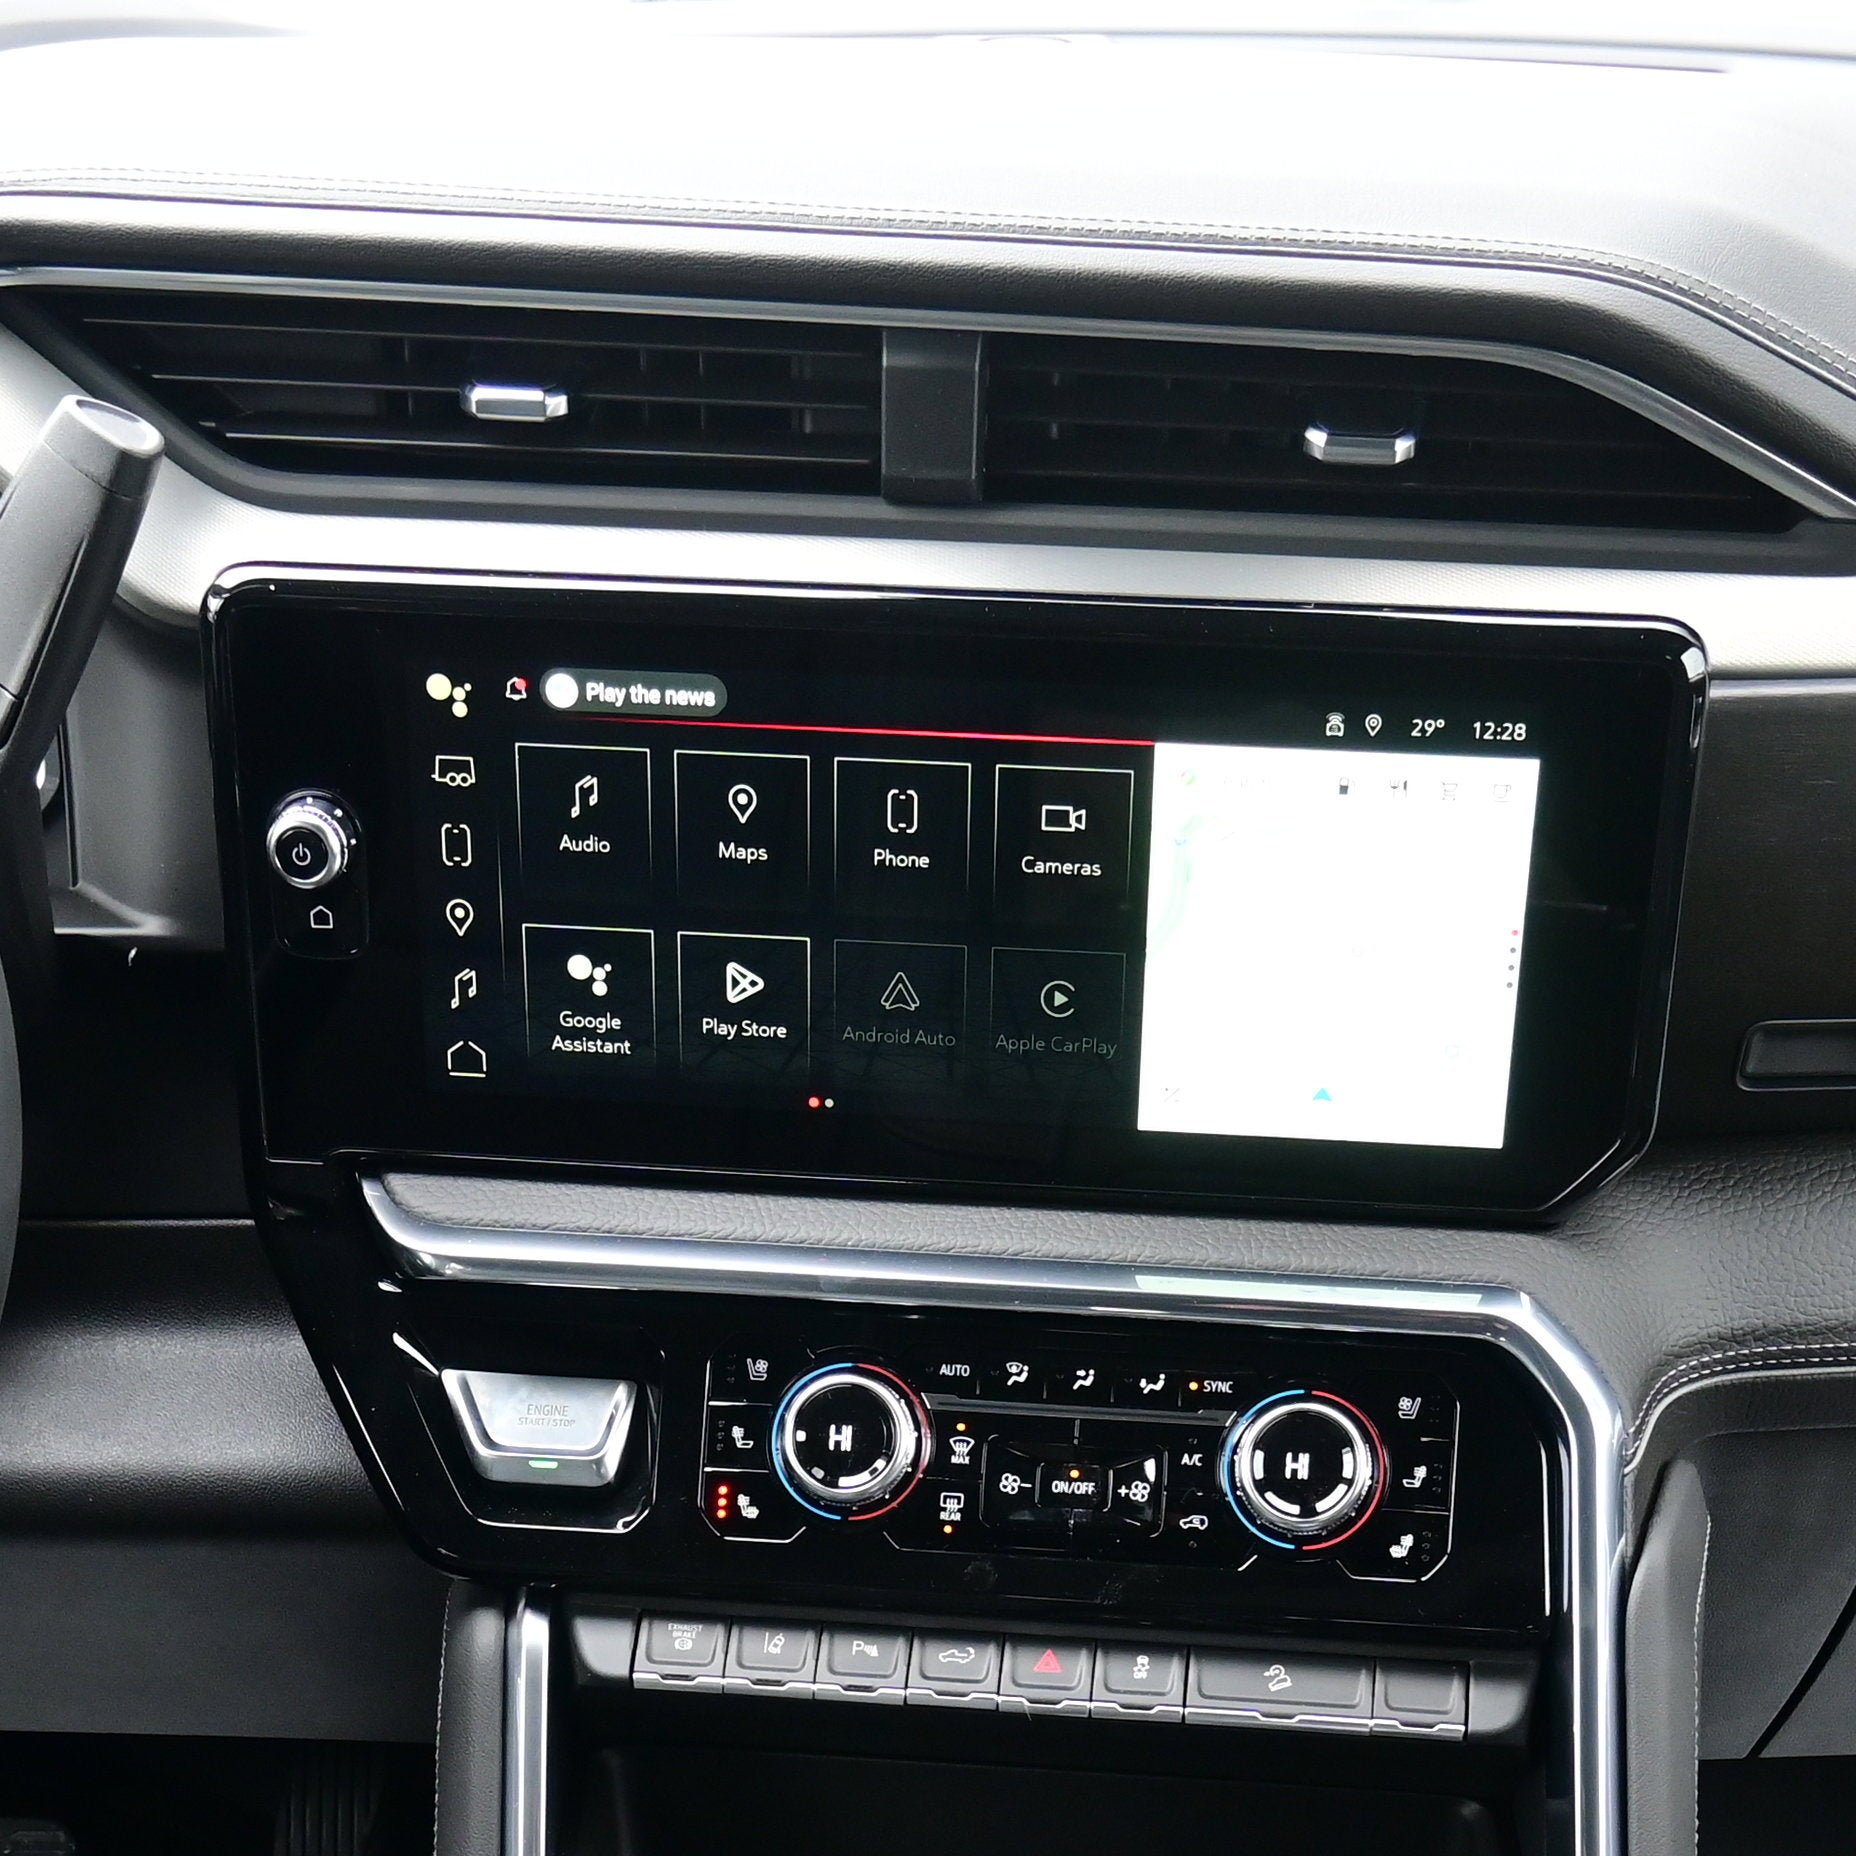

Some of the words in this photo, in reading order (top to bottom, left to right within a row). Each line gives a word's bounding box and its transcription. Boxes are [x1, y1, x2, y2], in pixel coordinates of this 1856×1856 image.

[586, 681, 626, 708] Play
[629, 683, 661, 705] the
[665, 688, 716, 707] news
[1472, 722, 1528, 742] 12:28
[559, 834, 611, 855] Audio
[718, 842, 769, 865] Maps
[873, 848, 930, 870] Phone
[1021, 856, 1102, 878] Cameras
[559, 1011, 622, 1035] Google
[702, 1018, 737, 1040] Play
[741, 1020, 787, 1039] Store
[551, 1035, 632, 1057] Assistant
[842, 1026, 910, 1045] Android
[914, 1030, 956, 1047] Auto
[995, 1034, 1045, 1054] Apple
[1050, 1036, 1118, 1058] CarPlay
[939, 1364, 970, 1377] AUTO
[1203, 1380, 1234, 1394] SYNC
[526, 1404, 569, 1417] ENGINE
[828, 1424, 853, 1452] HI
[951, 1455, 970, 1465] MAX
[1180, 1453, 1203, 1467] A/C
[1284, 1452, 1310, 1481] HI
[1051, 1481, 1096, 1496] ON/OFF
[939, 1512, 961, 1522] REAR
